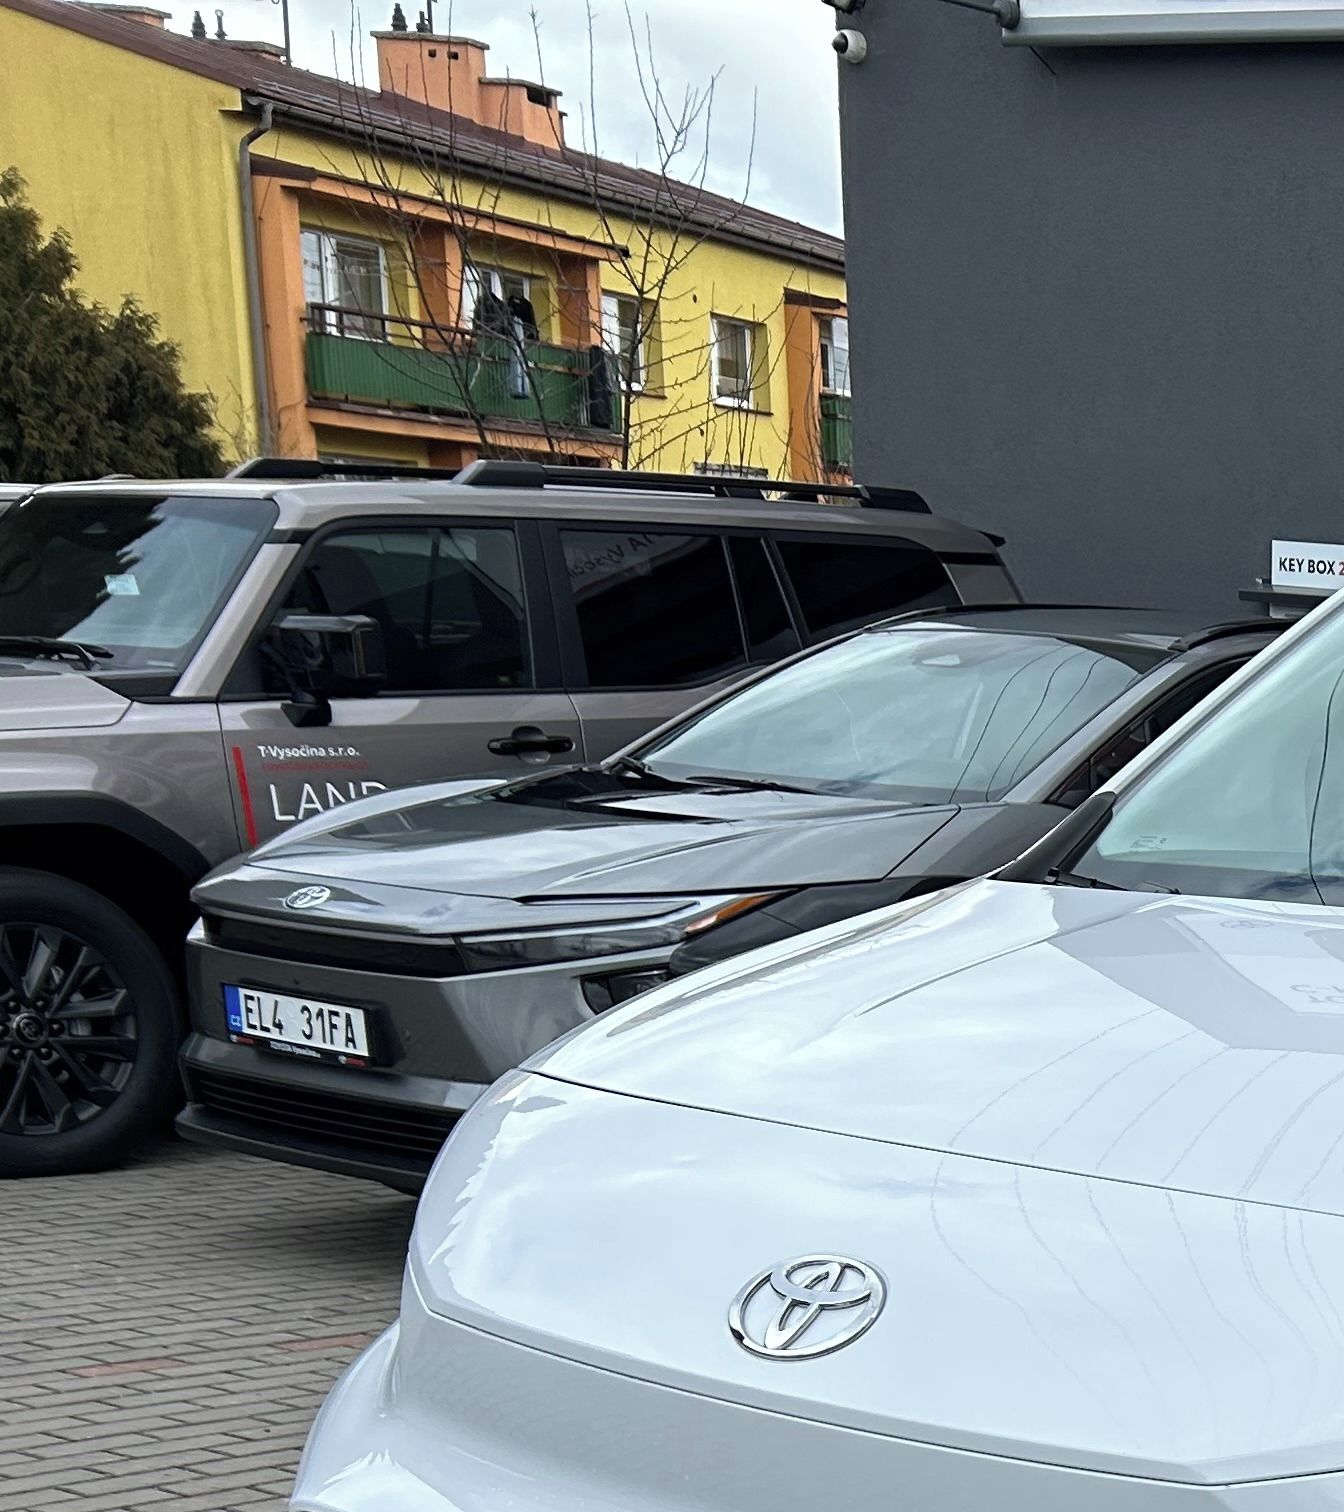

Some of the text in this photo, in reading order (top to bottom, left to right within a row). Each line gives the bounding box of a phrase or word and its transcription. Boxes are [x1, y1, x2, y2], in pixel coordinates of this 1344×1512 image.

[1278, 556, 1304, 573] KEY
[1307, 559, 1336, 576] BOX
[328, 746, 361, 757] s.r.o.
[243, 994, 358, 1050] EL4 31FA
